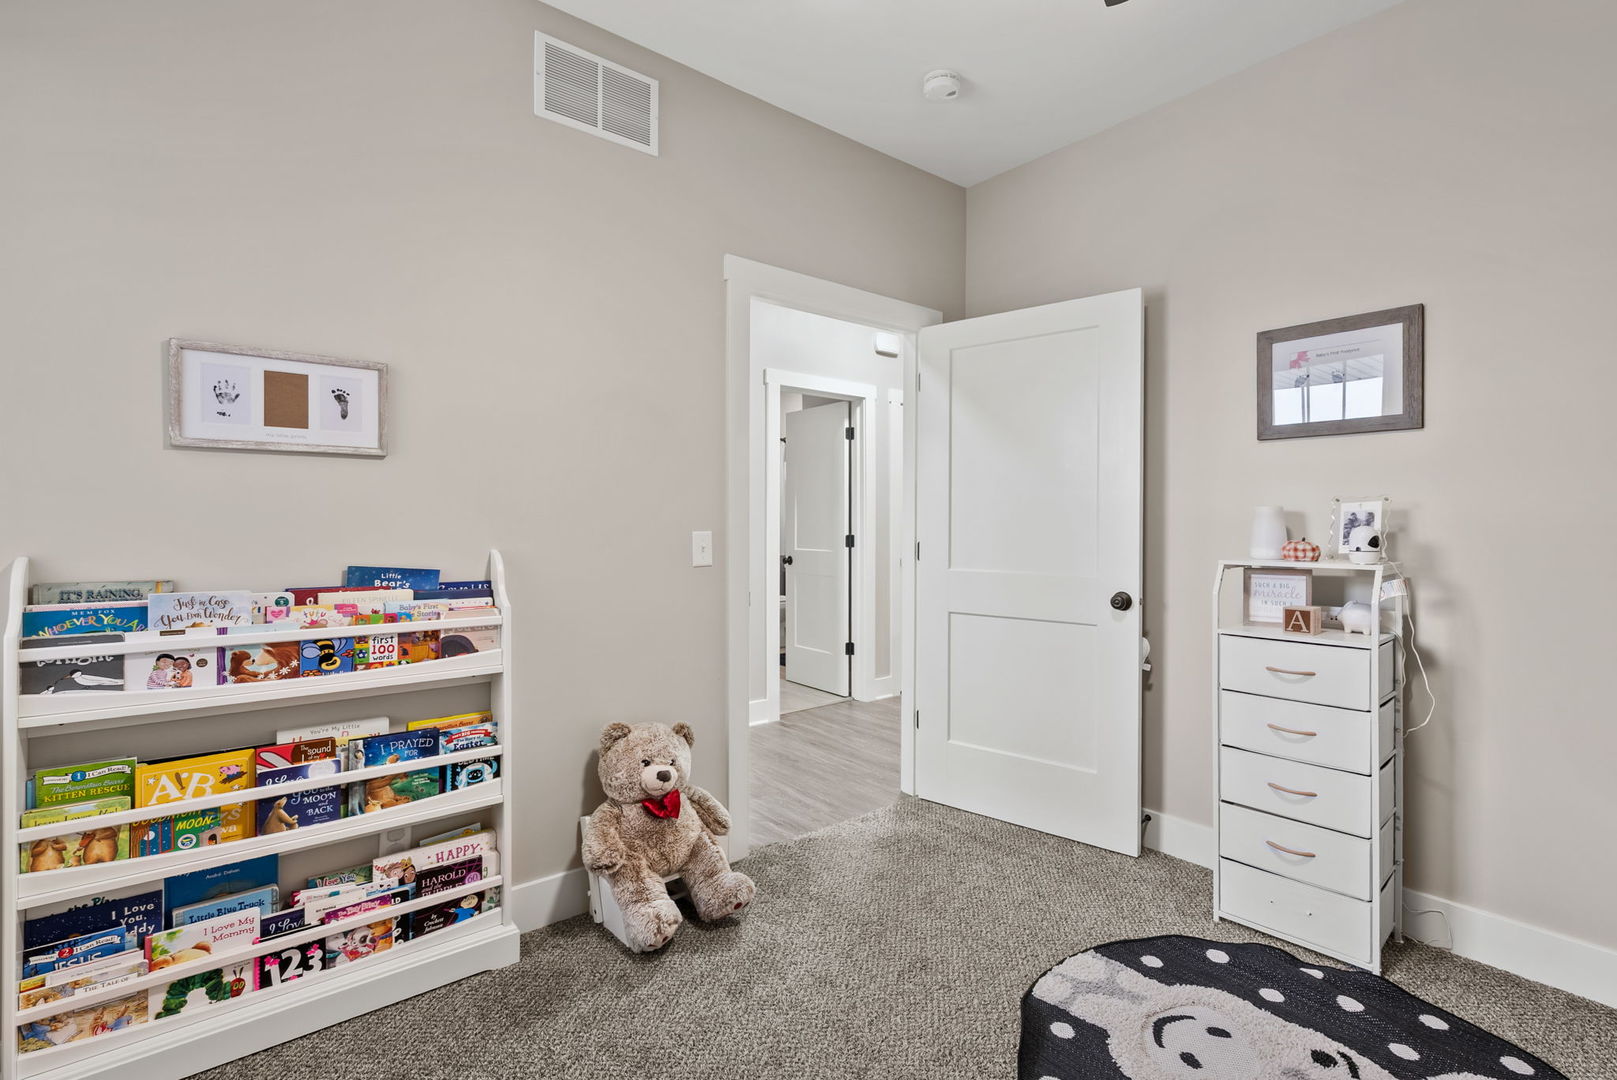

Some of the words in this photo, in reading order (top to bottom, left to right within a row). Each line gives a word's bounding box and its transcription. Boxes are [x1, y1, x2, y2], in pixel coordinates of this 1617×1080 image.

[374, 580, 411, 589] Bear's
[59, 590, 83, 600] IT'S
[173, 596, 196, 611] Just
[208, 595, 230, 609] Case
[203, 607, 242, 625] Wonder
[1286, 610, 1309, 633] A
[372, 635, 395, 644] first
[371, 644, 395, 654] 100
[308, 740, 332, 755] sound
[380, 744, 386, 755] I
[390, 738, 434, 753] PRAYED
[44, 790, 86, 802] KITTEN
[90, 784, 130, 796] RESCUE
[303, 791, 337, 804] MOON
[306, 805, 334, 816] BACK
[175, 816, 214, 831] MOON
[436, 843, 480, 863] HAPPY
[421, 868, 466, 888] HAROLD
[124, 903, 155, 916] Love
[217, 905, 238, 917] Blue
[238, 899, 265, 911] Truck
[211, 922, 236, 934] Love
[238, 916, 255, 926] My
[212, 926, 256, 943] Mommy
